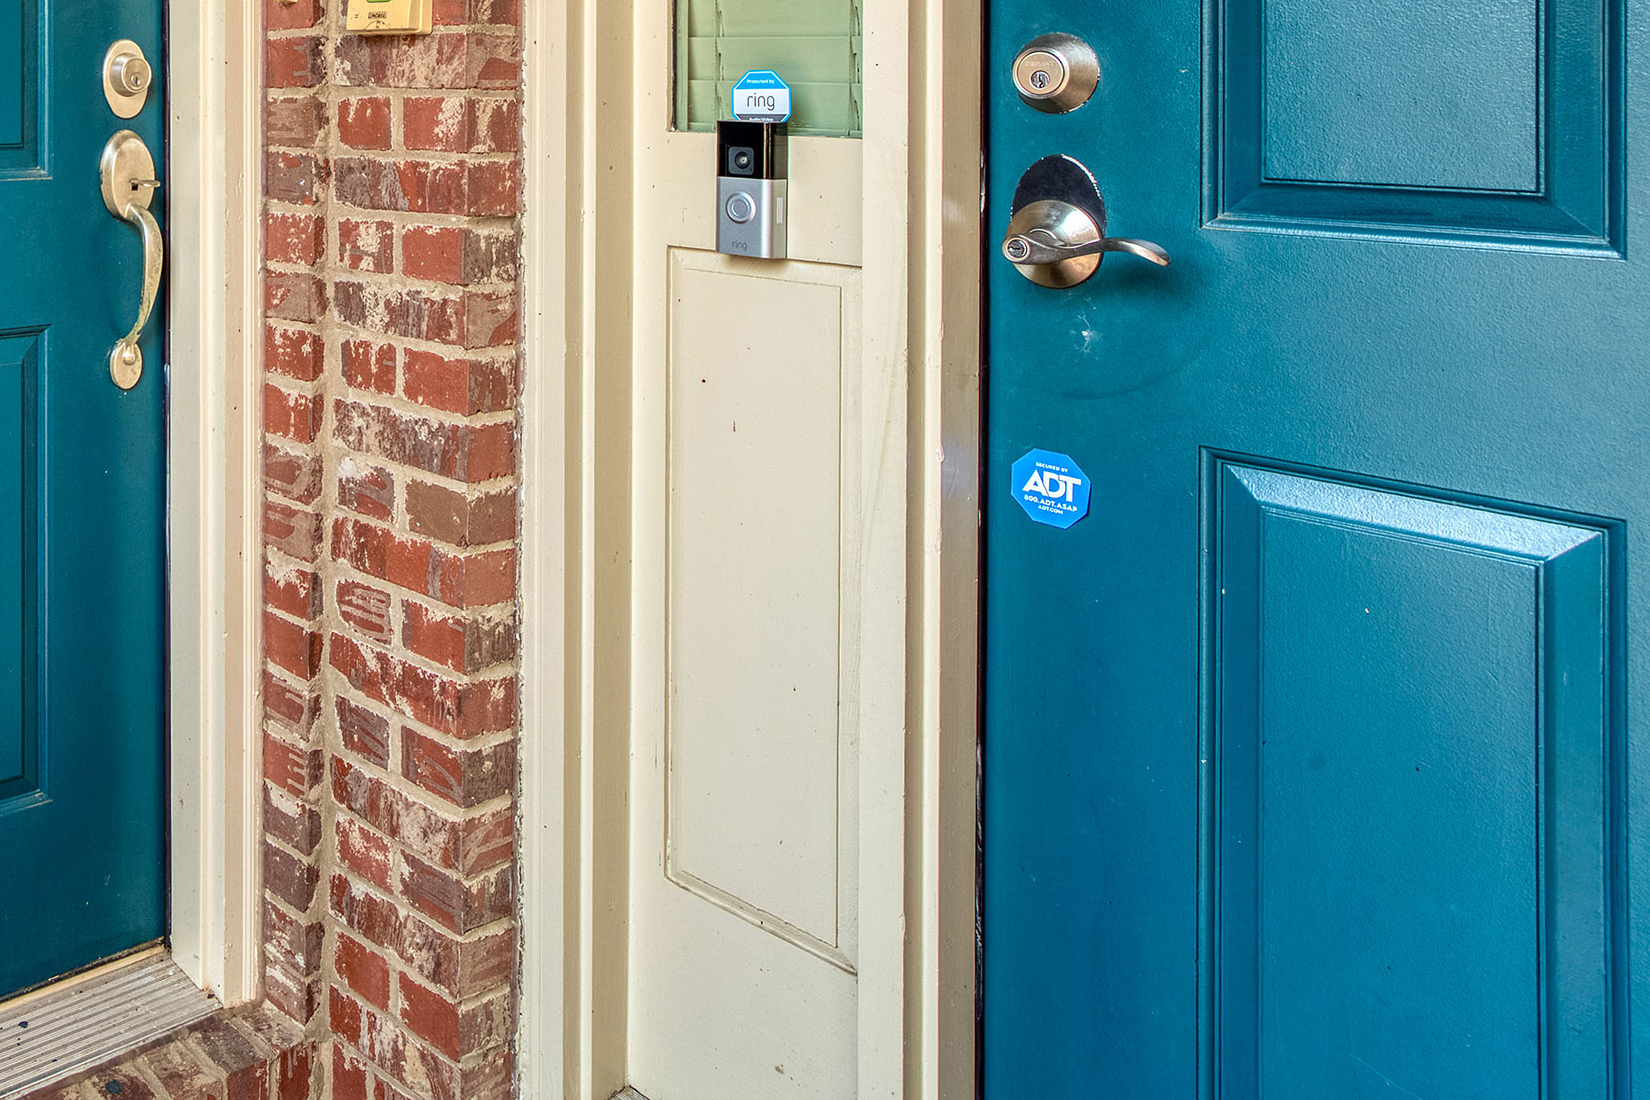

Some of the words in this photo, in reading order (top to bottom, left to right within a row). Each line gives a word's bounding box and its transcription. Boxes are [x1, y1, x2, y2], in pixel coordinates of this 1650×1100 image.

[747, 92, 775, 111] ring
[732, 240, 748, 251] ring
[1035, 461, 1060, 471] SECURED
[1022, 469, 1082, 502] ADT
[1038, 504, 1064, 515] ADT.COM
